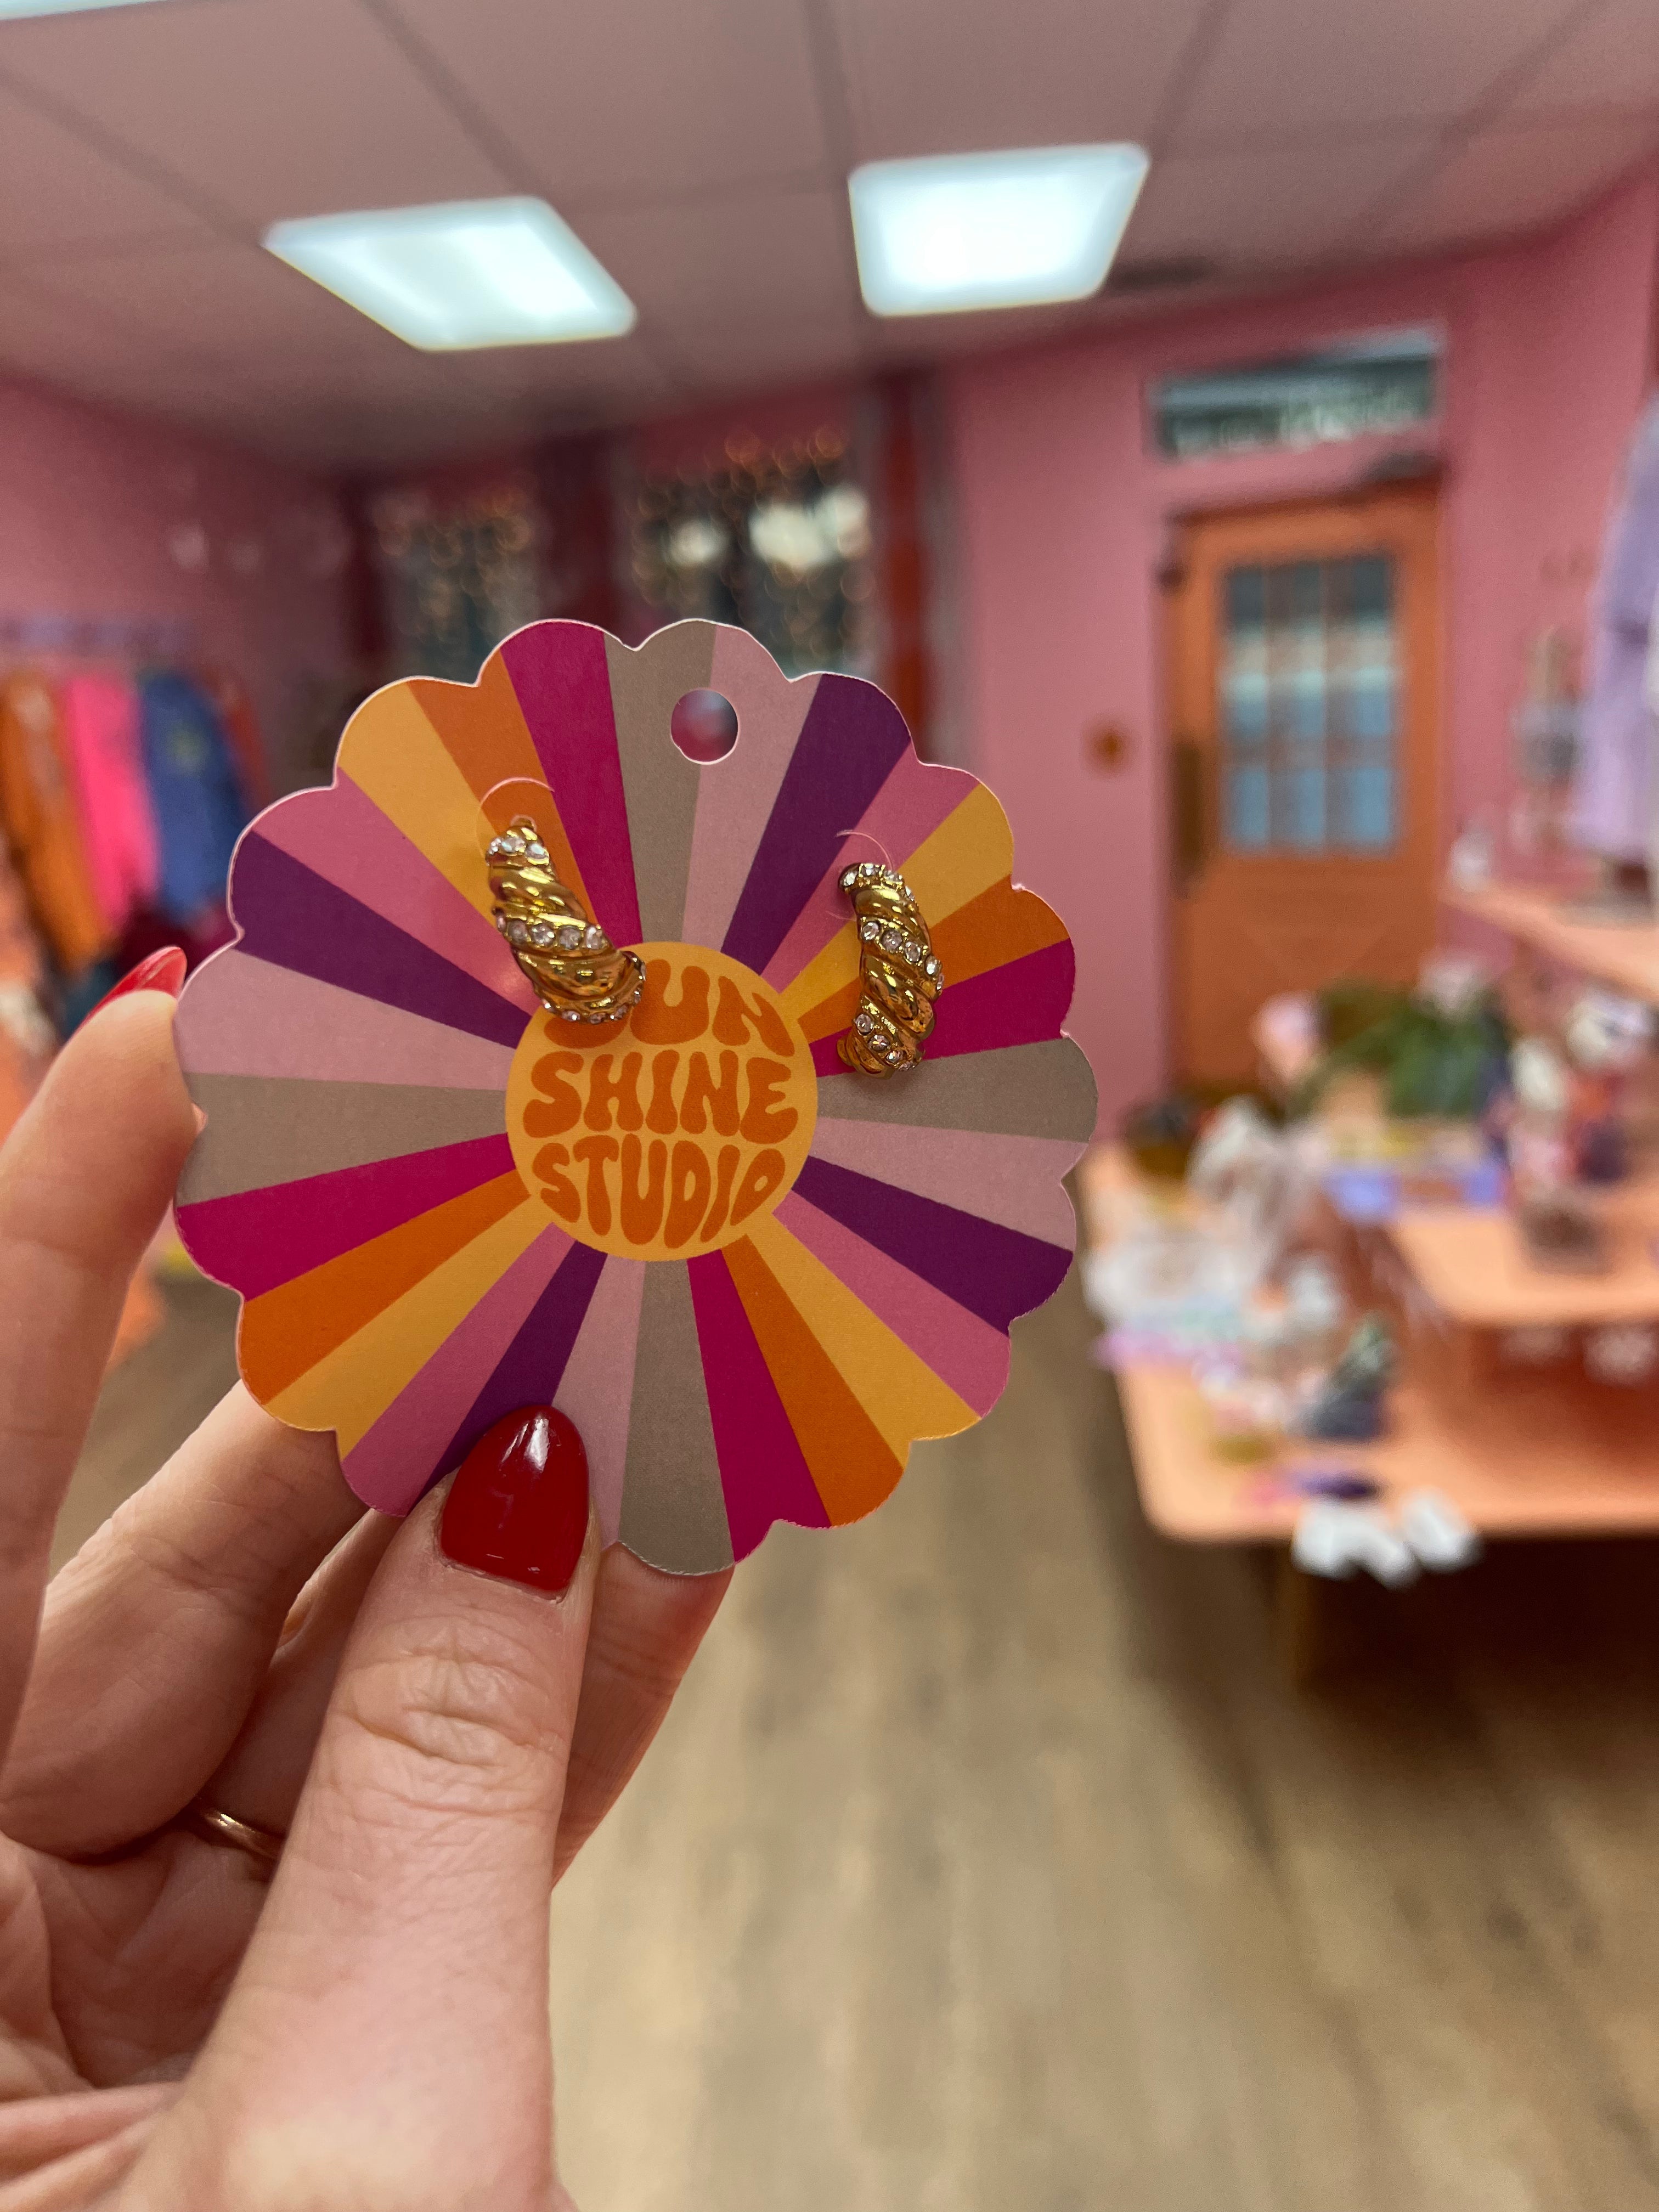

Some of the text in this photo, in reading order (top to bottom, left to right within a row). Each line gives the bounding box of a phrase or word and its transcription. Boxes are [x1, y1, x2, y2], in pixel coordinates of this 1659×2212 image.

[544, 958, 795, 1057] UN
[522, 1049, 799, 1145] SHINE
[532, 1133, 786, 1249] STUDIO
